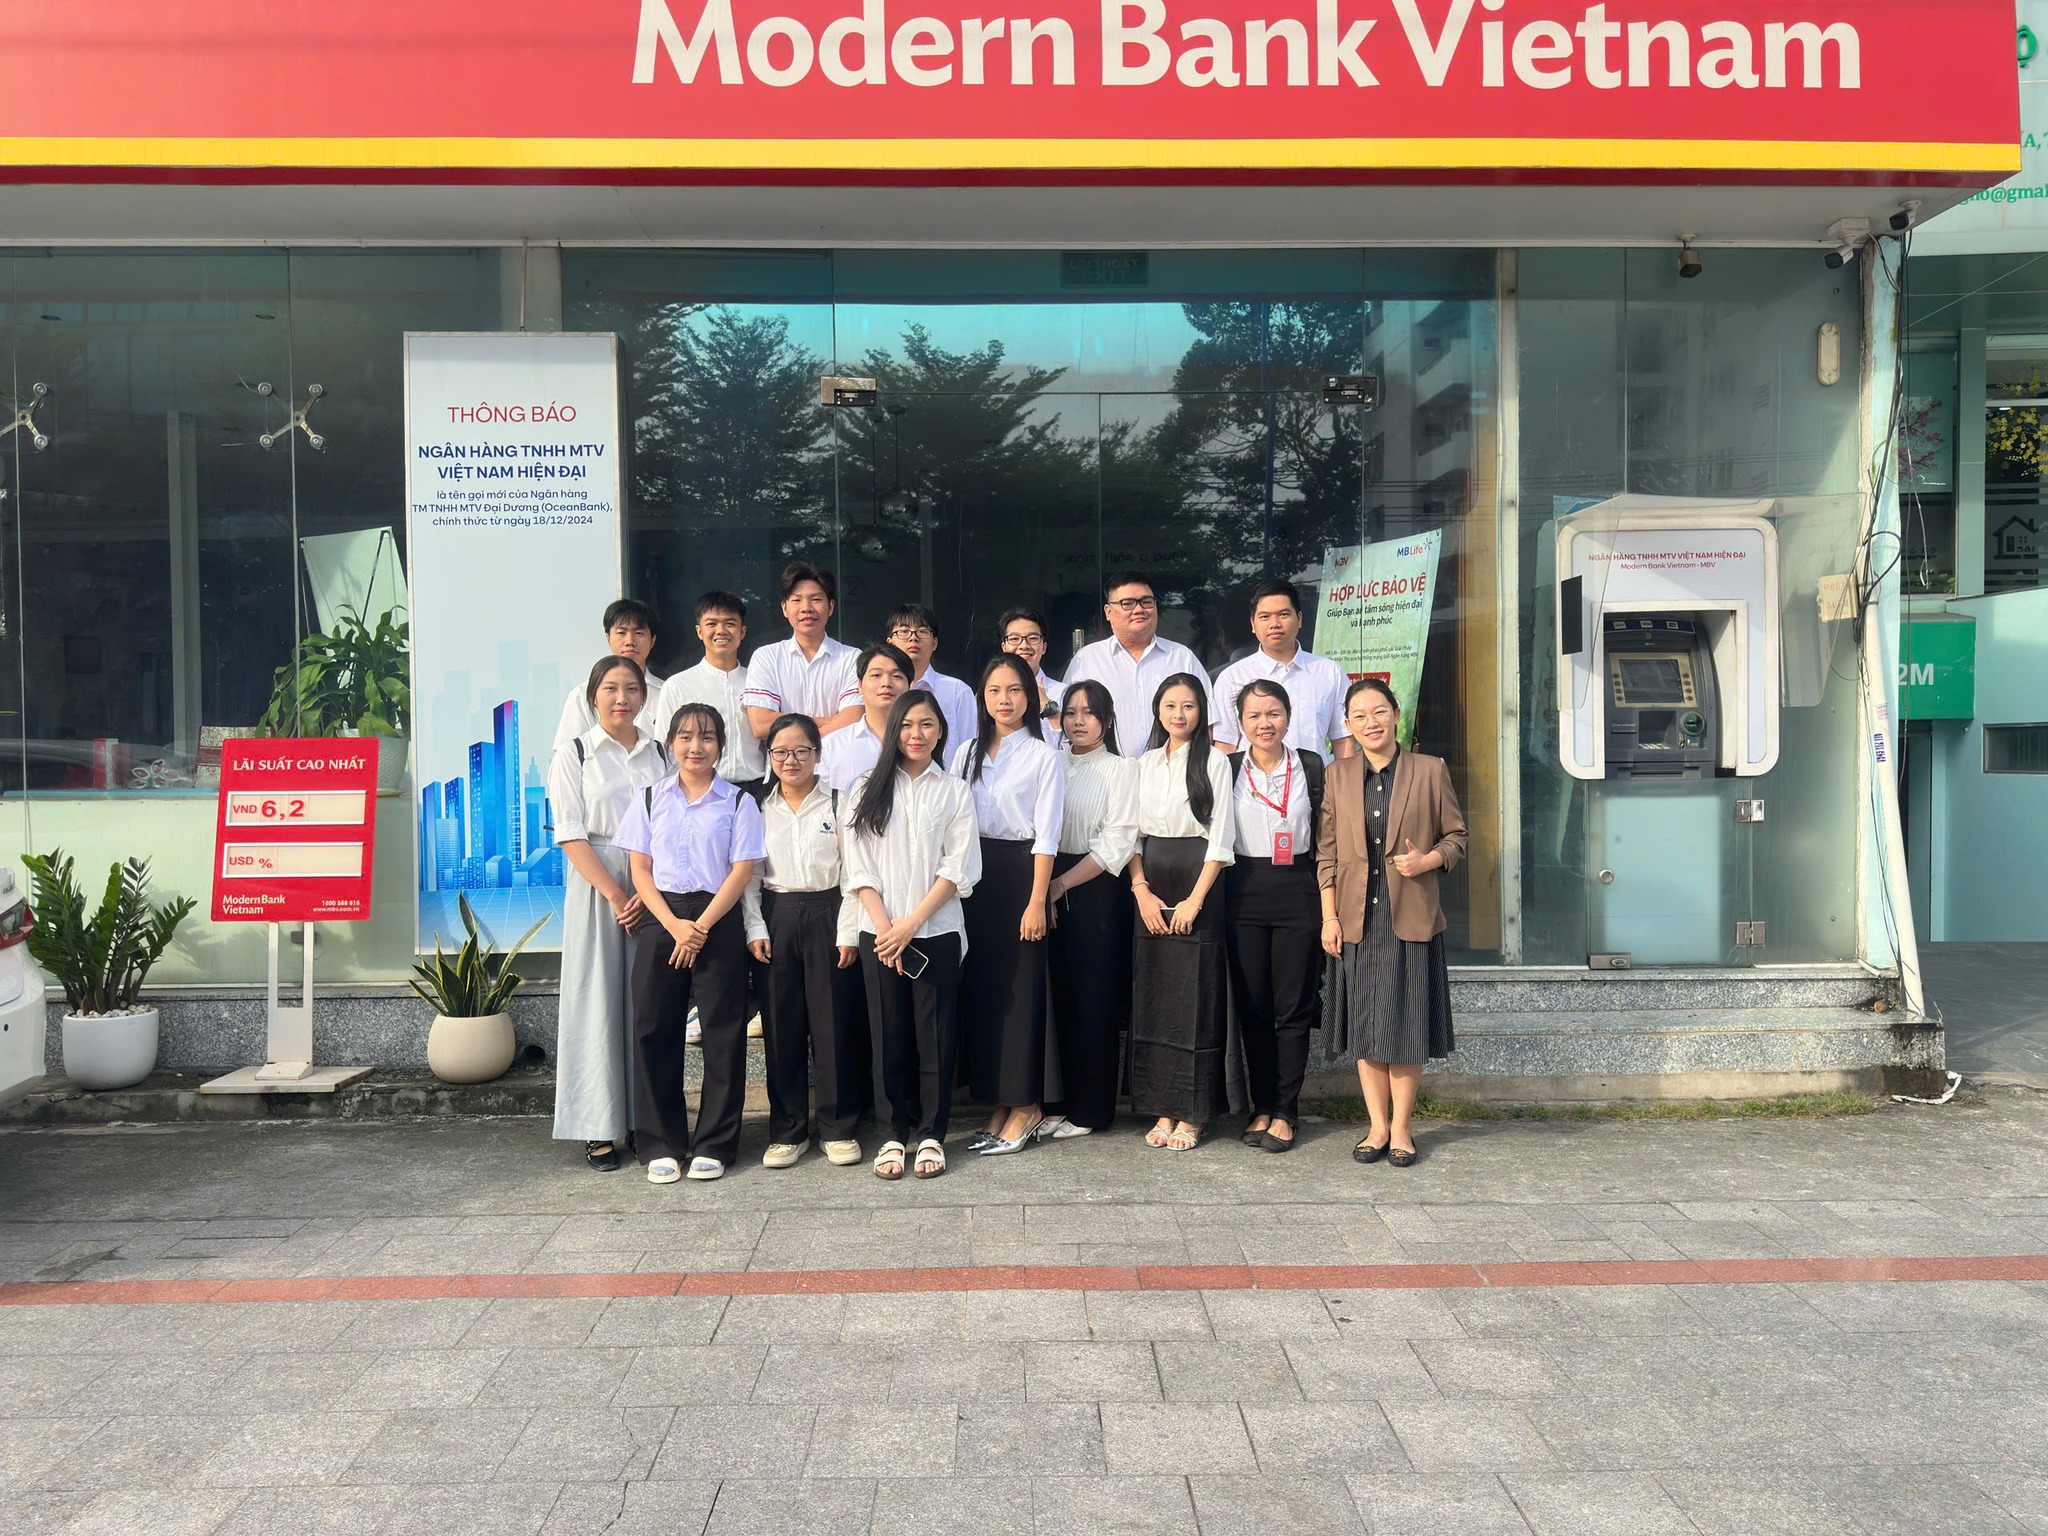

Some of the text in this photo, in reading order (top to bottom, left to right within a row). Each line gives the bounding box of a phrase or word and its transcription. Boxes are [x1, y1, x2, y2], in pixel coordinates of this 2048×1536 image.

[632, 0, 1861, 89] Modern Bank Vietnam
[447, 401, 577, 423] THÔNG BÁO
[418, 442, 604, 458] NGÂN HÀNG TNHH MTV
[437, 462, 586, 482] VIỆT NAM HIỆN ĐẠI
[436, 490, 588, 502] là tên gọi mới của Ngân hàng
[412, 502, 613, 515] TM TNHH MTV Đại Dương (OceanBank),
[432, 515, 593, 527] chính thức từ ngày 18/12/2024
[1588, 553, 1612, 561] NGÂN
[1613, 552, 1637, 560] HÀNG
[1677, 551, 1694, 561] VIỆT
[1714, 550, 1732, 560] HIỆN
[1733, 551, 1746, 560] ĐẠI
[1329, 572, 1427, 606] HỢP LỰC BẢO VỆ
[1327, 608, 1342, 618] Giúp
[1343, 608, 1354, 618] Bạn
[233, 755, 366, 771] LÃI SUẤT CAO NHẤT
[232, 799, 305, 820] VND 6,2
[229, 856, 272, 869] USD %
[223, 894, 285, 905] Modern Bank
[222, 904, 263, 915] Vietnam
